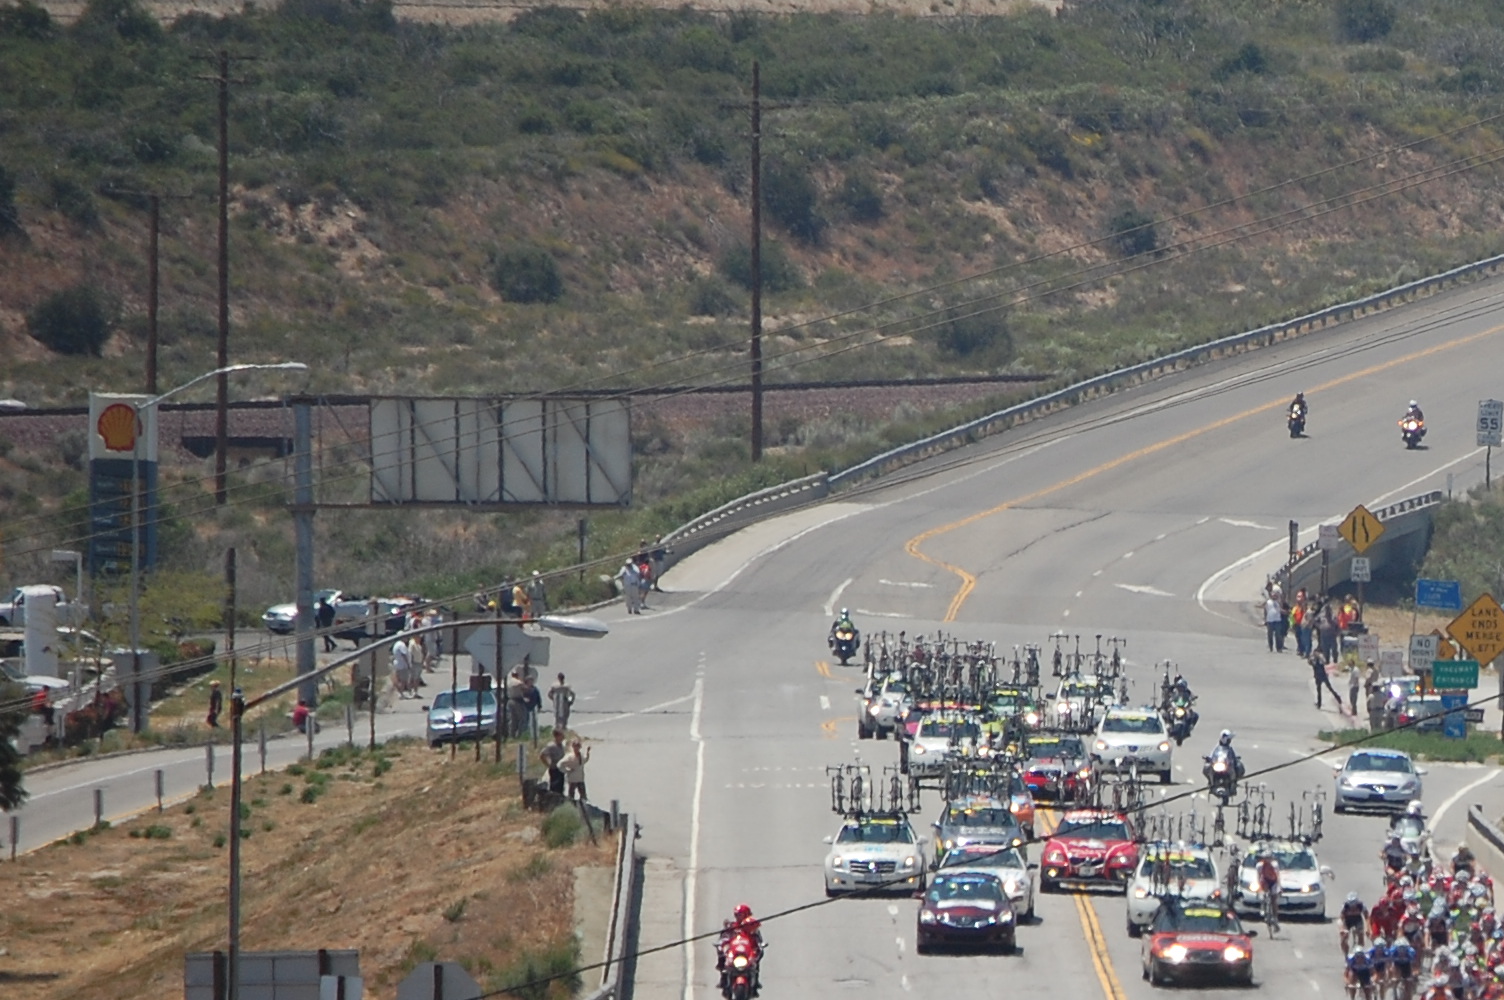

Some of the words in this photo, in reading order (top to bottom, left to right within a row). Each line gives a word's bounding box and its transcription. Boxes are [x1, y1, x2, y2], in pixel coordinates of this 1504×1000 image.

[1480, 417, 1499, 430] 55
[1472, 608, 1498, 616] LANE
[1472, 620, 1497, 629] ENDS
[1466, 631, 1502, 640] MERGE
[1417, 639, 1431, 648] NO
[1472, 644, 1496, 652] LEFT
